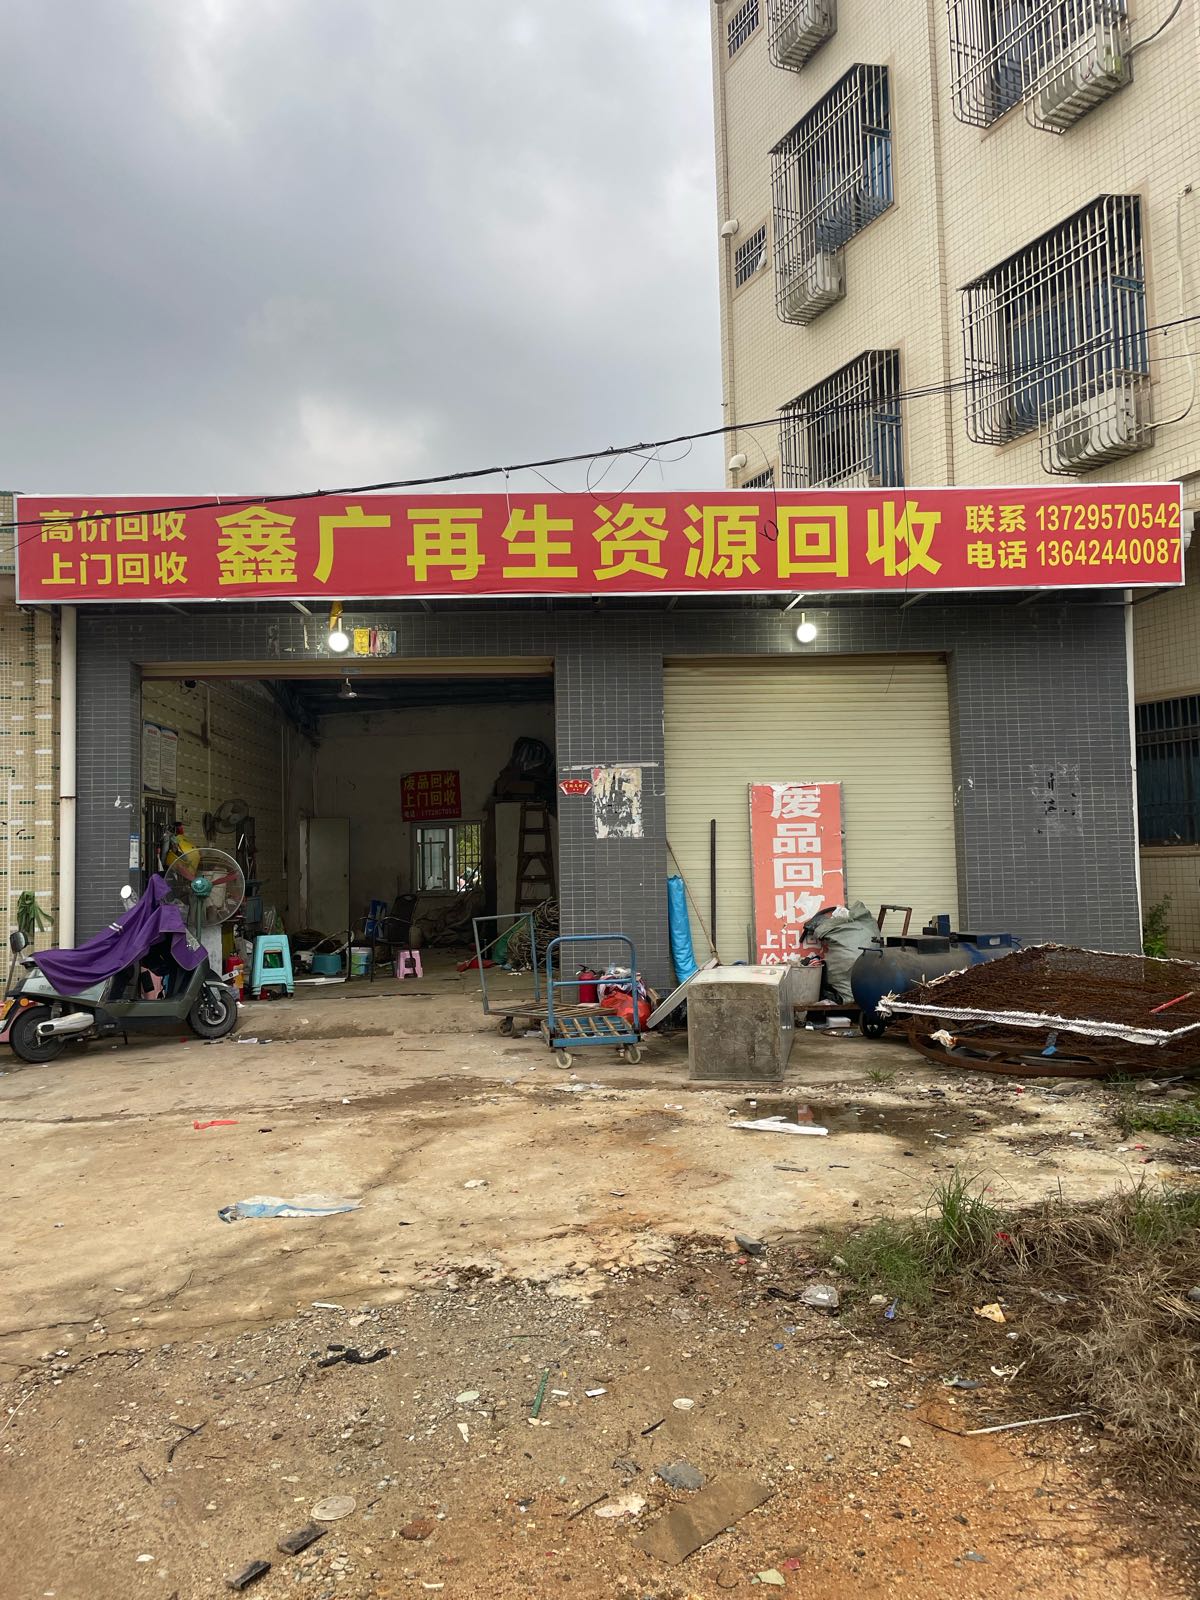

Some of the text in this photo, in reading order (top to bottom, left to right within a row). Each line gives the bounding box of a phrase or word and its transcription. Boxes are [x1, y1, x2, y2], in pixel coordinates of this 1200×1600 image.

[39, 510, 187, 543] 高价回收
[965, 502, 1180, 533] 联系 13729570542
[215, 501, 942, 584] 鑫广再生资源回收
[967, 538, 1180, 569] 电话 13642440087
[41, 552, 188, 585] 上门回收
[404, 772, 455, 791] 废品回收
[403, 790, 456, 808] 上门回收
[770, 783, 825, 924] 废品回收
